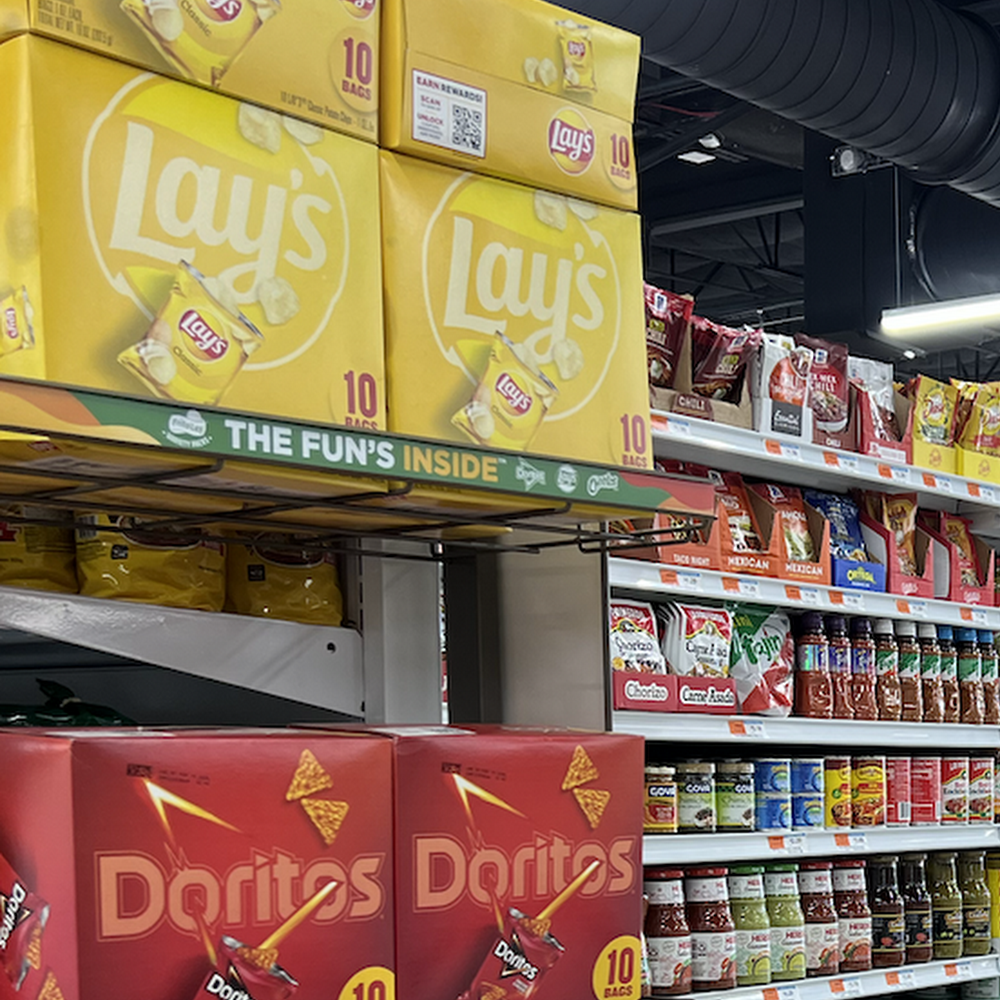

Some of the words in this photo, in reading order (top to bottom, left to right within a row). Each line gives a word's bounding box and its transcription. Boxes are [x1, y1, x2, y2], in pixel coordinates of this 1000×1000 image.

[343, 37, 373, 85] 10
[341, 80, 373, 101] BAGS
[416, 76, 440, 90] EARN
[441, 84, 484, 103] REWARDS!
[551, 120, 593, 161] Lay's
[611, 133, 630, 168] 10
[109, 121, 331, 305] Lay's
[443, 214, 607, 357] Lay's
[179, 312, 229, 358] Lay's
[343, 370, 378, 418] 10
[496, 373, 533, 412] Lay's
[225, 419, 293, 457] THE
[302, 430, 396, 470] FUN'S
[403, 444, 500, 483] INSIDE
[620, 413, 647, 455] 10
[622, 454, 648, 469] BAGS
[727, 556, 770, 571] MEXICAN
[785, 563, 824, 577] MEXICAN
[626, 681, 668, 700] Chorizo
[735, 784, 754, 794] GOY
[413, 834, 637, 912] Doritos
[95, 850, 387, 941] Doritos
[494, 940, 541, 981] Doritos
[607, 948, 634, 987] 10
[604, 984, 633, 999] BAGS
